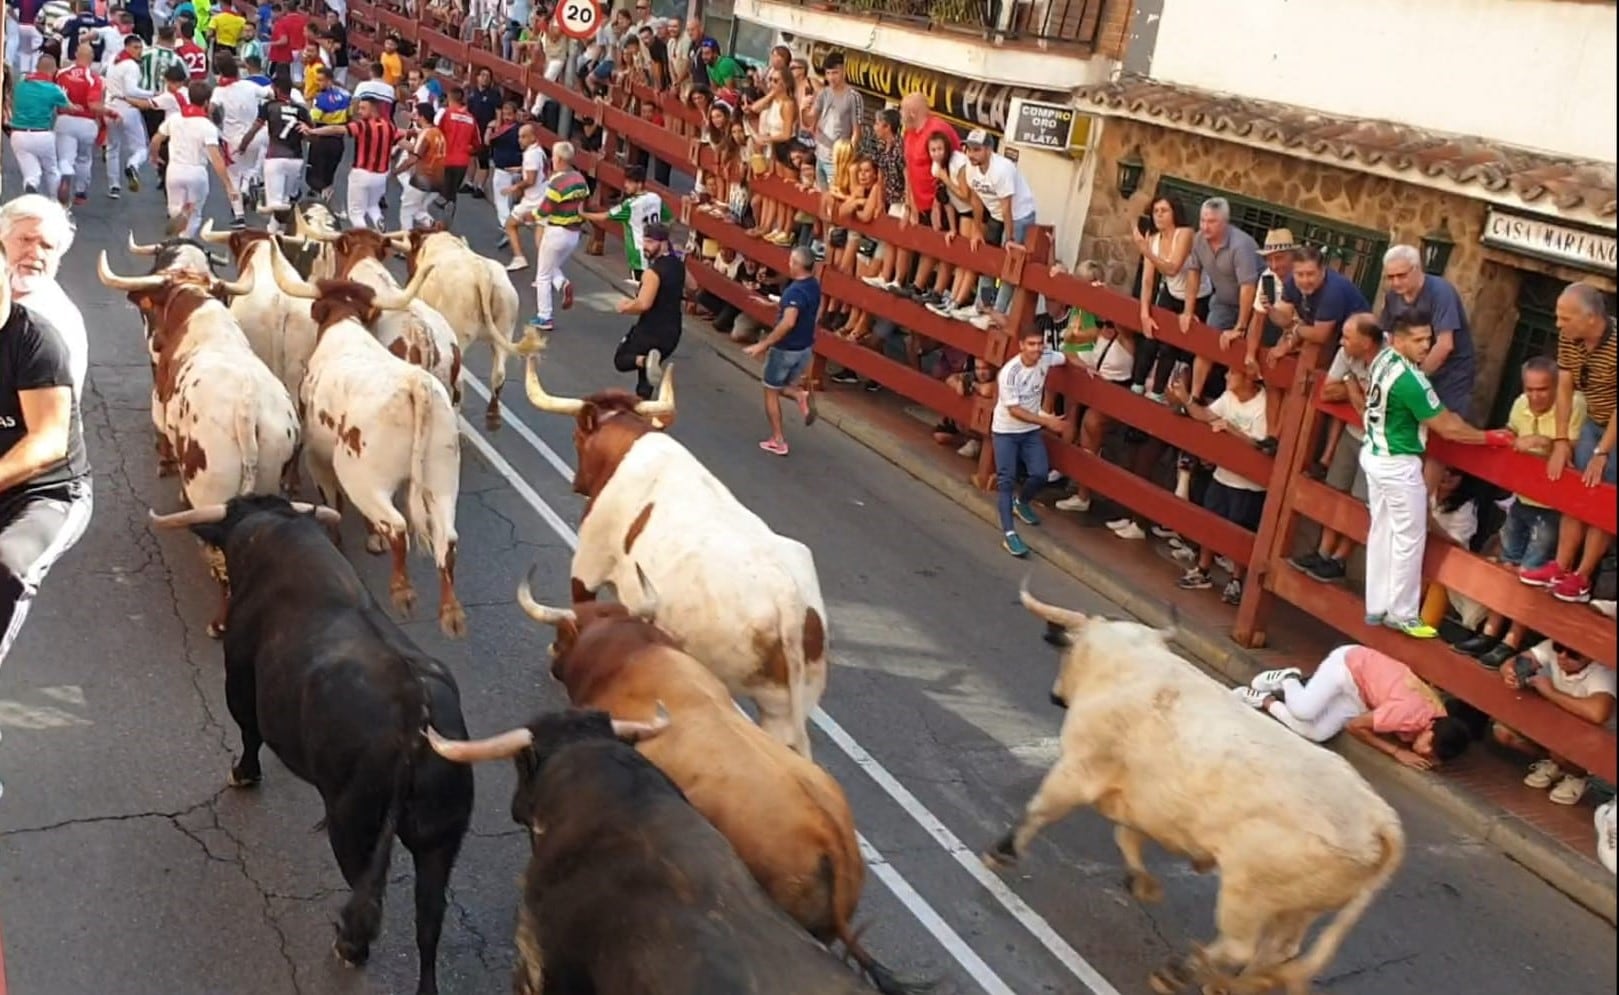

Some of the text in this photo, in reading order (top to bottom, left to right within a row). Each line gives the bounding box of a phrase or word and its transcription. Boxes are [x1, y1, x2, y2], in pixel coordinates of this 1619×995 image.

[567, 4, 592, 23] 20
[184, 52, 207, 72] 23
[1021, 105, 1073, 121] COMPRO
[279, 114, 298, 139] 7
[1032, 116, 1058, 129] ORO
[1022, 133, 1060, 146] PLATA
